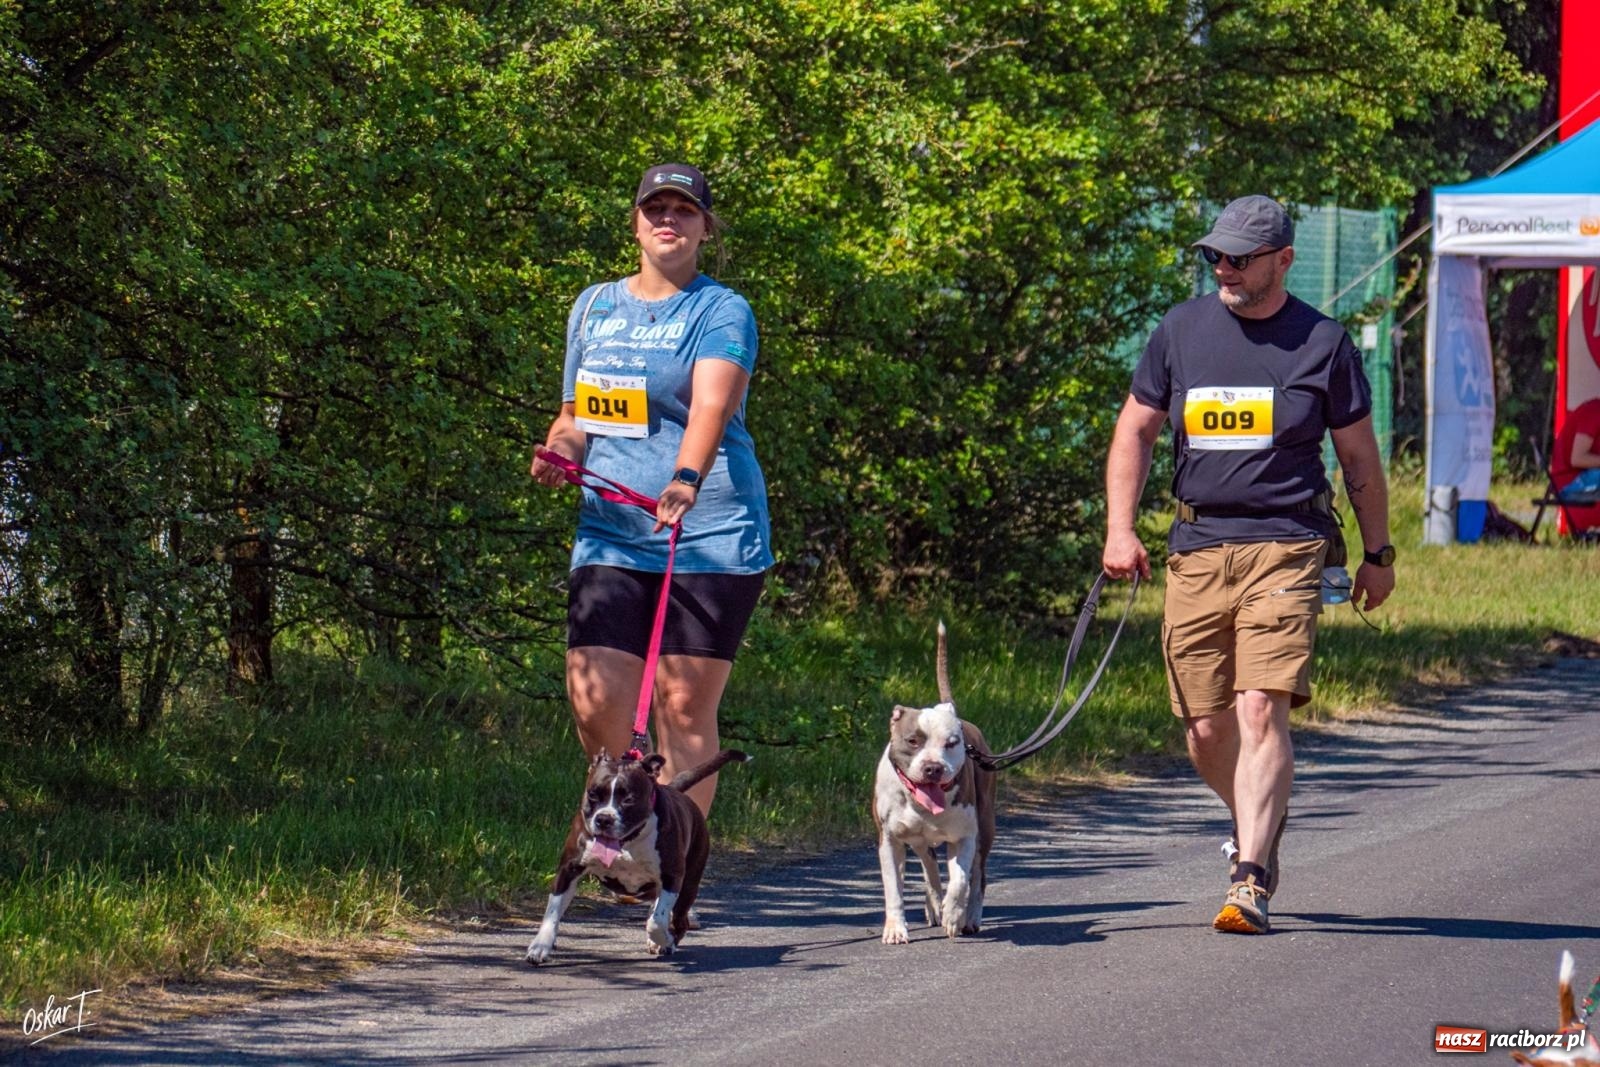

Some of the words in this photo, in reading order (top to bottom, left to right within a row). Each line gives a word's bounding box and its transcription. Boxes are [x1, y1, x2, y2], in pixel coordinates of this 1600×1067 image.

[1457, 216, 1572, 234] PersonalBest
[630, 322, 686, 340] DAVID
[588, 396, 629, 418] 014
[1203, 410, 1254, 430] 009
